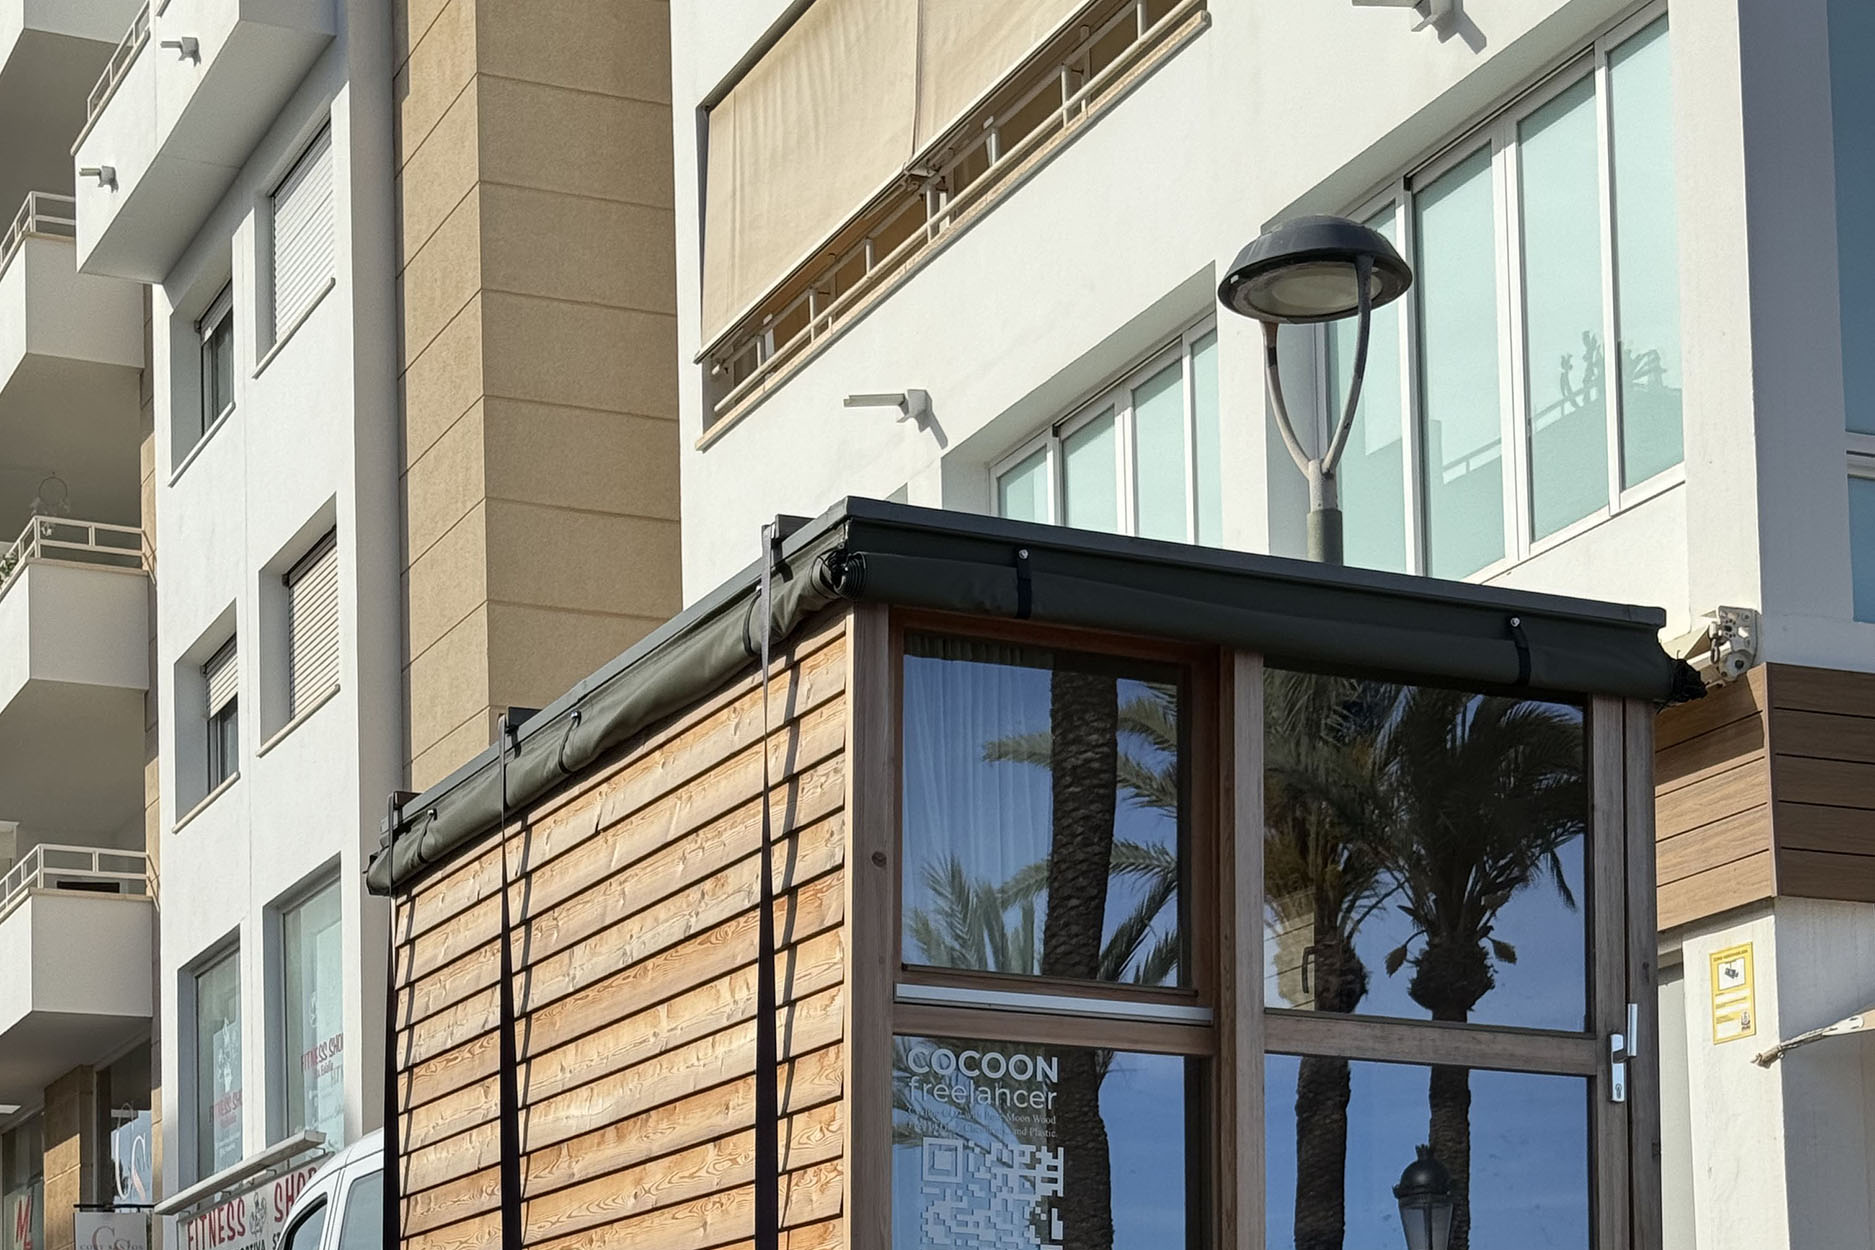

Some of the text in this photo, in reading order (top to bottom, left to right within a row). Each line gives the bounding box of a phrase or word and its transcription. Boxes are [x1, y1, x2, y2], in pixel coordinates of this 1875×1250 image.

[907, 1048, 1059, 1083] COCOON
[909, 1076, 1057, 1110] freelancer
[1032, 1113, 1057, 1125] Wood
